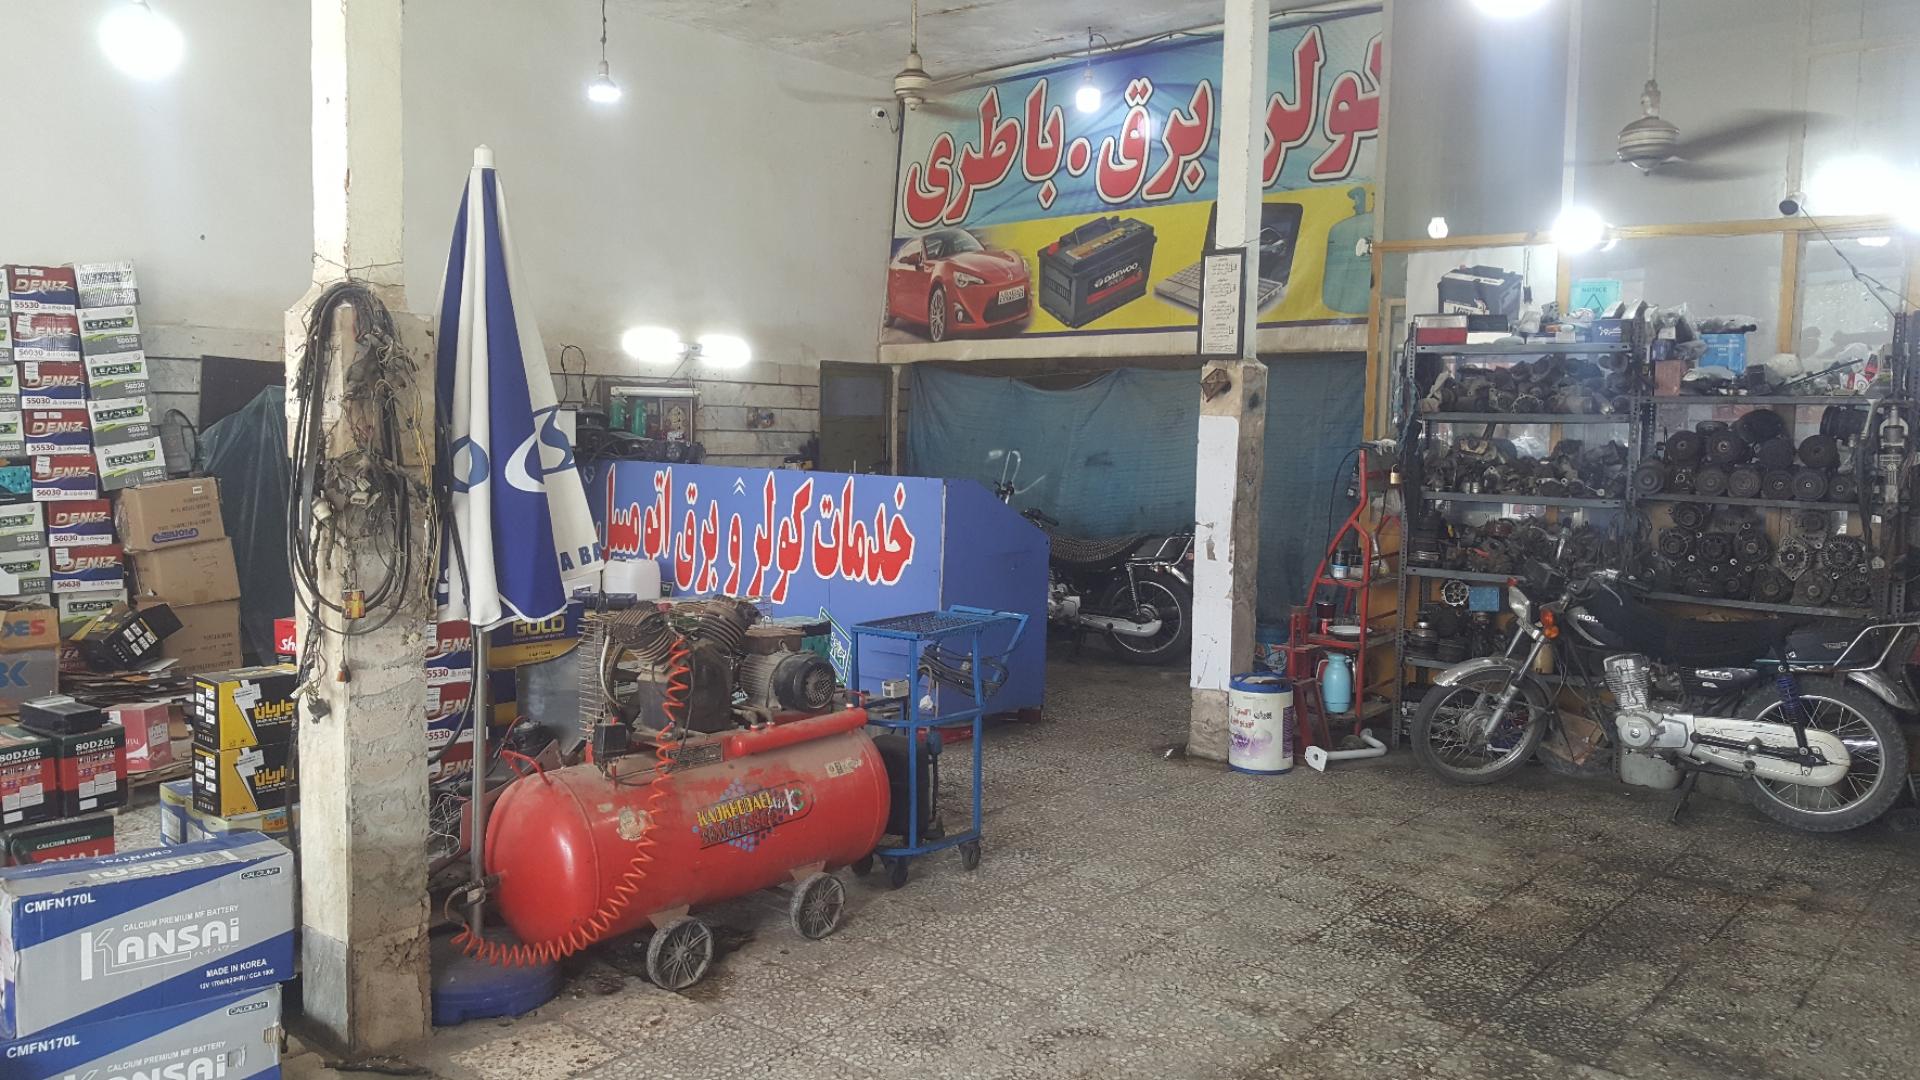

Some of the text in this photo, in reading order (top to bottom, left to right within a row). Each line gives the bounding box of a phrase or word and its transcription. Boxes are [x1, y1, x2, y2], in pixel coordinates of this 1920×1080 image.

[1096, 76, 1215, 205] برق
[903, 77, 1065, 229] باطری
[1104, 262, 1138, 283] DAEWOO
[15, 279, 68, 291] DENIZ
[32, 421, 83, 433] DENIZ
[37, 489, 61, 497] 56030
[56, 511, 106, 524] DENIZ
[674, 482, 719, 594] برق
[747, 471, 814, 604] کولر
[813, 476, 915, 586] خدمات
[61, 556, 116, 570] DENIZ
[723, 512, 742, 597] و
[427, 669, 449, 678] 5530
[75, 737, 115, 751] 80D26L
[426, 730, 450, 740] 5530
[36, 835, 91, 850] CALCIUM BATTERY
[25, 893, 96, 914] CMFN170L
[123, 918, 157, 932] CALCIUM
[159, 912, 194, 926] PREMIUM
[206, 904, 239, 918] BATTERY
[206, 958, 267, 978] MADE IN KOREA
[7, 1034, 80, 1058] CMFN170L
[107, 1059, 143, 1073] CALCIUM
[143, 1051, 179, 1066] PREMIUM
[192, 1041, 226, 1056] BATTERY
